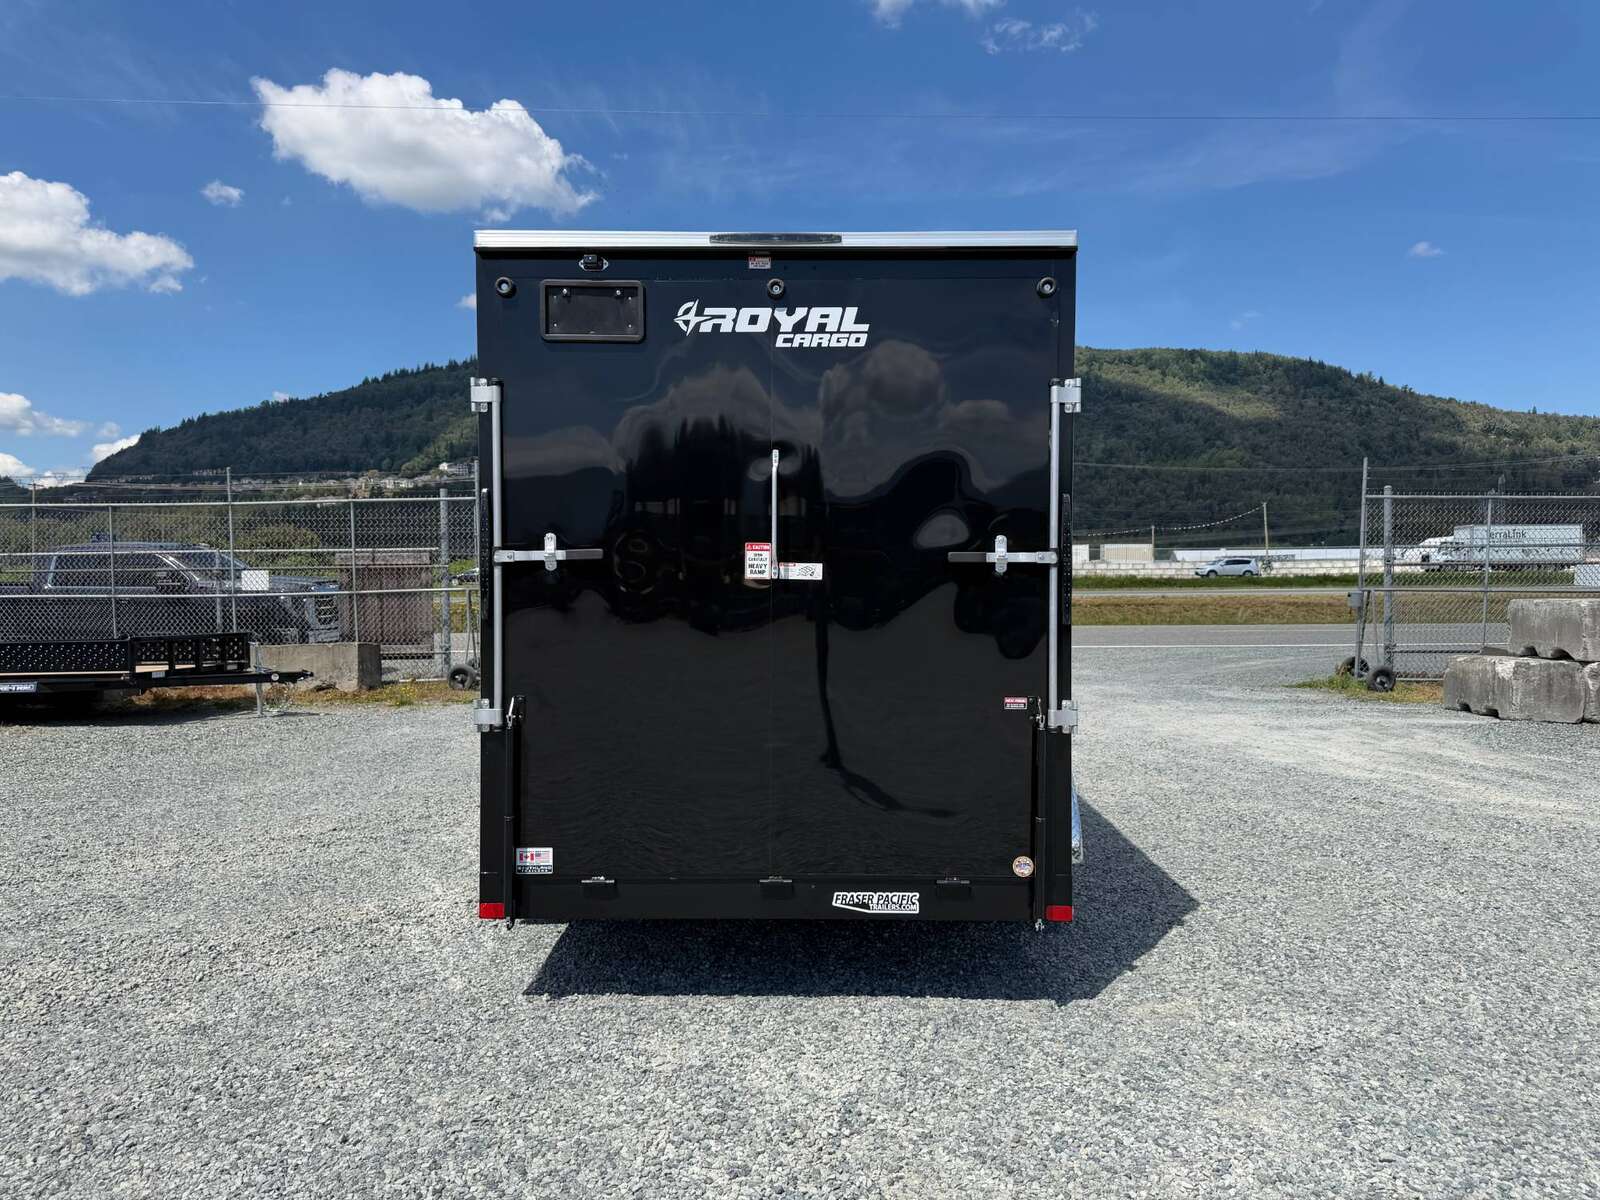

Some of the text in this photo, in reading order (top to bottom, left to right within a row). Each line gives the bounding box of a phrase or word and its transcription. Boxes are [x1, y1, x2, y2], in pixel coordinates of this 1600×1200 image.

[699, 306, 870, 333] ROYAL
[775, 333, 869, 348] CARGO
[1487, 528, 1527, 539] erraLink
[834, 893, 918, 905] FRASER PACIFIC
[869, 903, 917, 911] TRAILERS.COM
